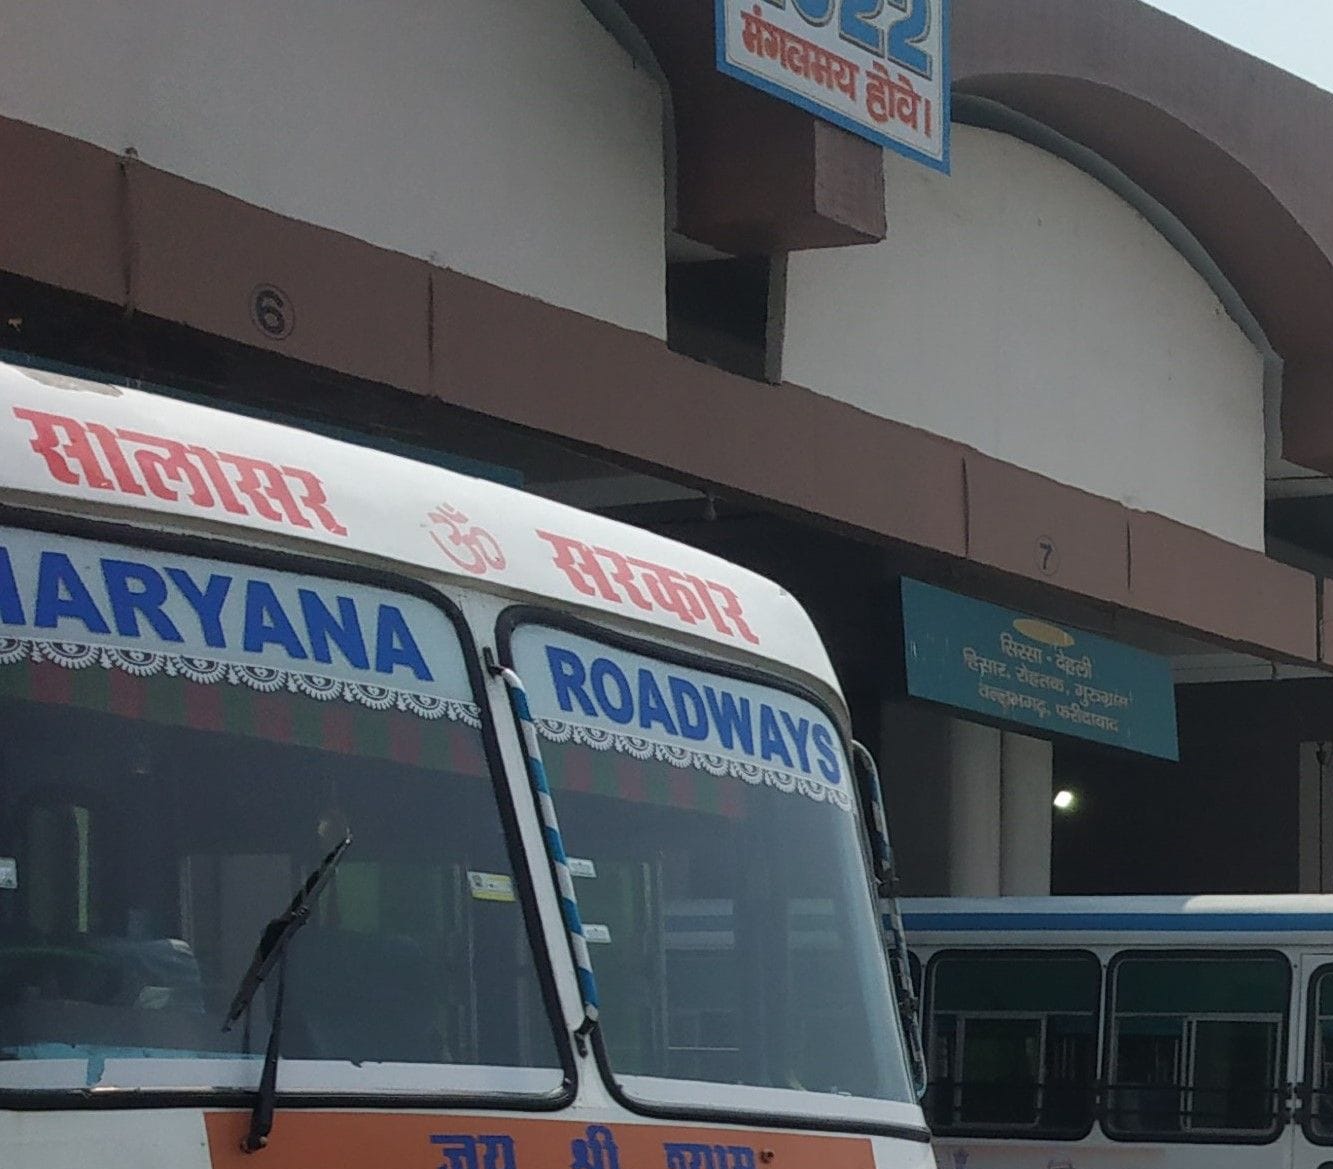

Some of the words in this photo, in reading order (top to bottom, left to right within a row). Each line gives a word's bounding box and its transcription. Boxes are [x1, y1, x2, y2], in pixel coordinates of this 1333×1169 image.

[740, 4, 860, 102] मंगलमय
[760, 0, 932, 81] 22
[255, 290, 286, 337] 6
[14, 406, 349, 537] सालासर
[535, 528, 761, 645] सरकार
[1039, 542, 1053, 571] 7
[545, 645, 843, 785] ROADWAYS
